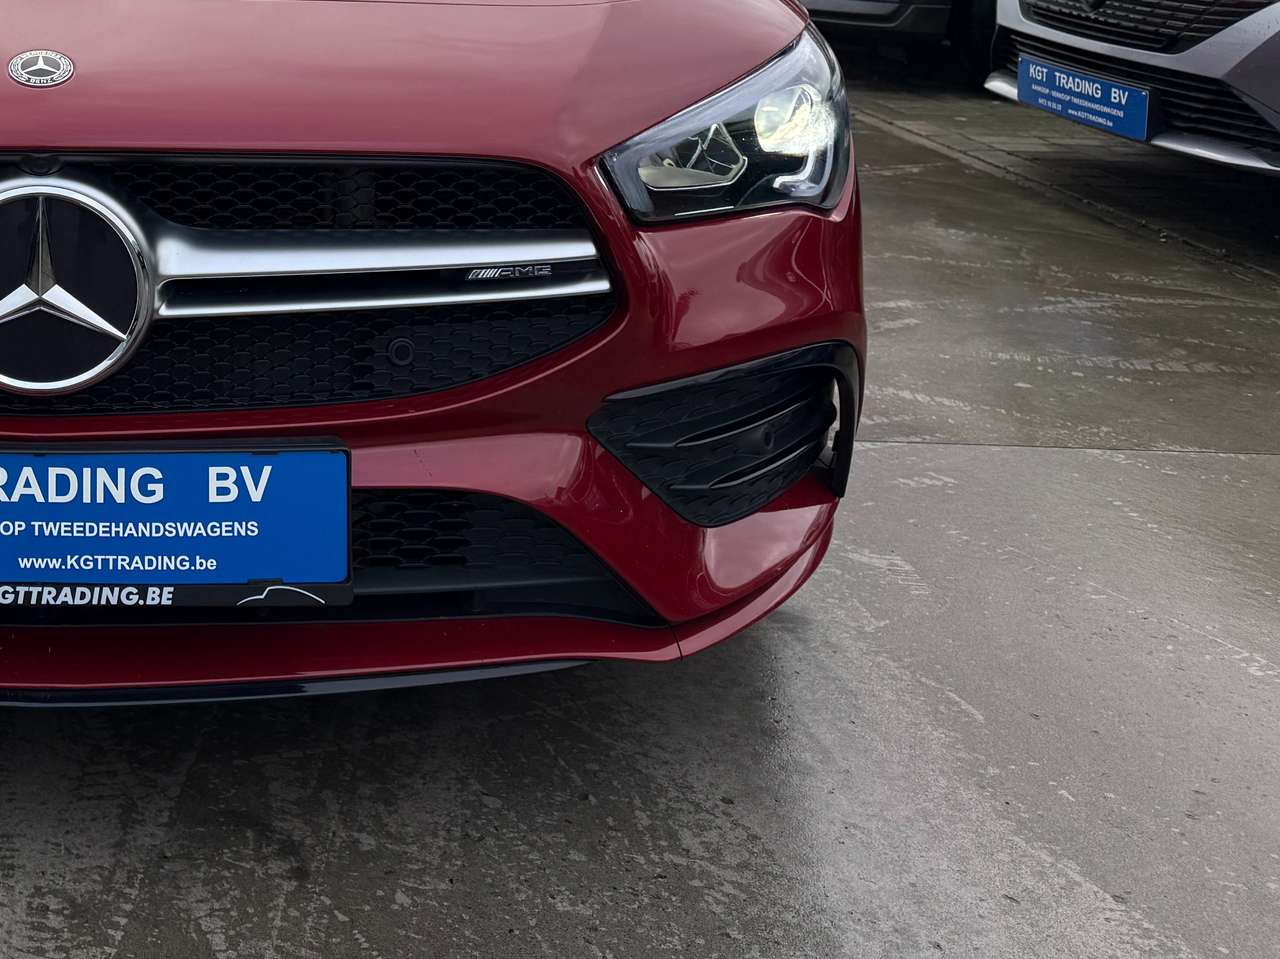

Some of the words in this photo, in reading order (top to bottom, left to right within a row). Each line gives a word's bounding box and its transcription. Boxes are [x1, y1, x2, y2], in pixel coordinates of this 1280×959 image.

[1029, 63, 1048, 82] KGT
[1054, 72, 1102, 98] TRADING
[1111, 88, 1129, 105] BV
[207, 465, 273, 504] BV
[31, 521, 259, 538] TWEEDEHANDSWAGENS
[18, 554, 217, 571] www.KGTTRADING.be
